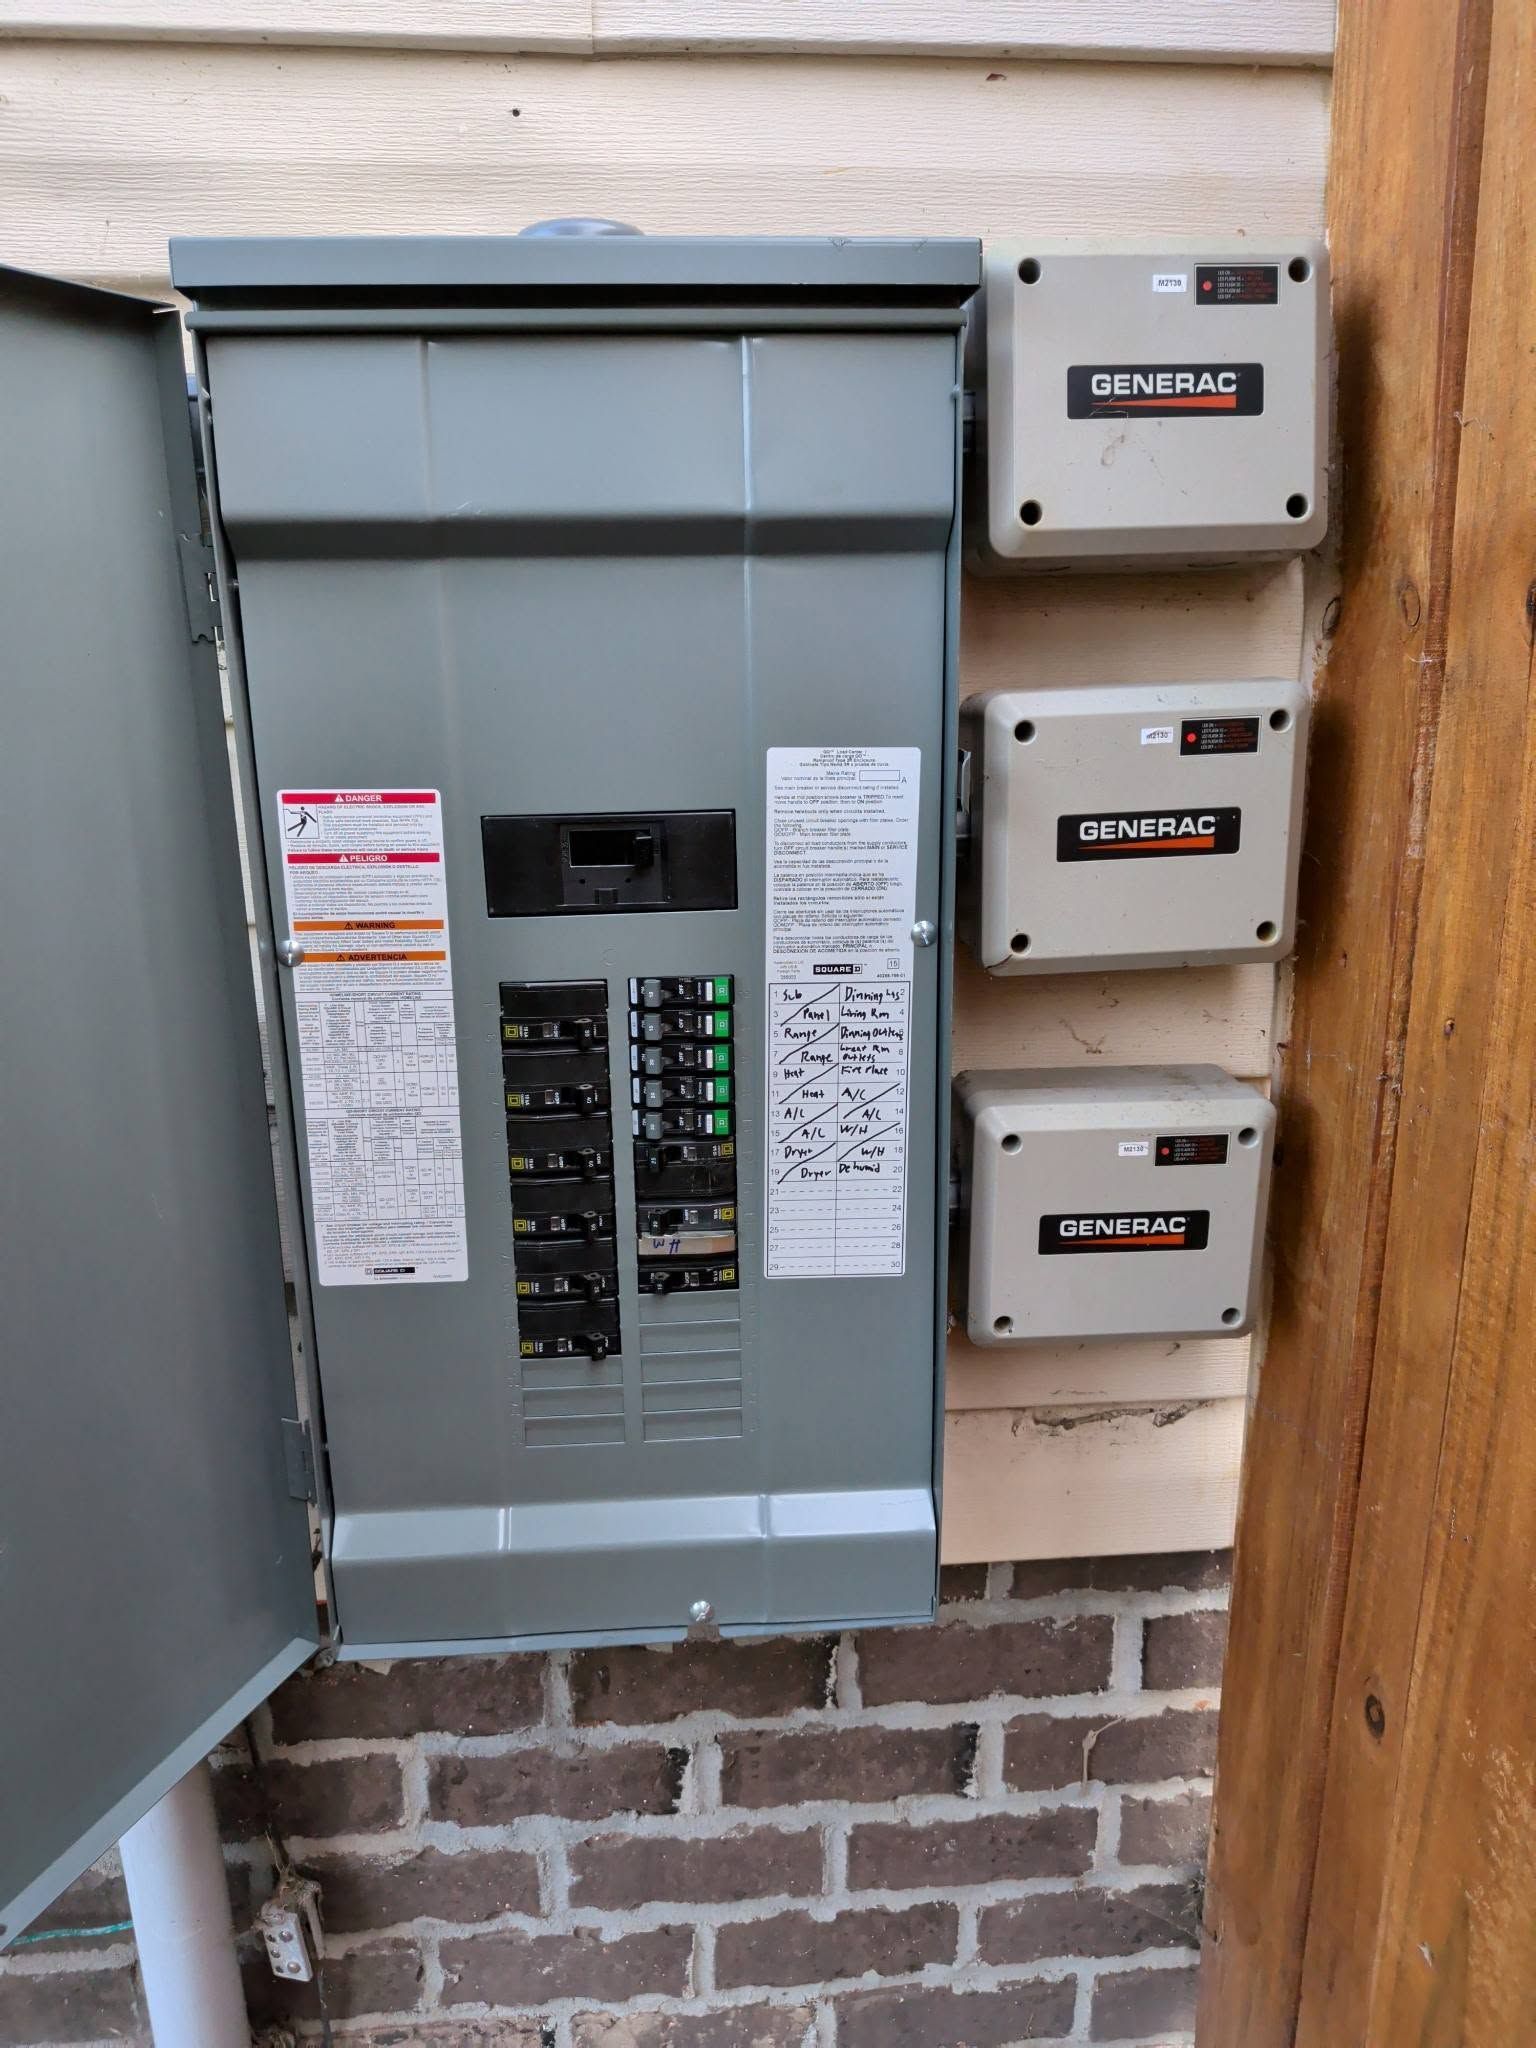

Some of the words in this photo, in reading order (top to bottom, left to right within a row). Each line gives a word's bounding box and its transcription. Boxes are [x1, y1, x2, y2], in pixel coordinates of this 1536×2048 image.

[1092, 373, 1237, 395] GENERAC
[1080, 816, 1215, 840] GENERAC
[815, 965, 852, 973] SQUARE
[783, 989, 802, 1000] Sub
[845, 987, 883, 1004] Dinning
[804, 1008, 830, 1021] Panel
[841, 1006, 866, 1020] Living
[871, 1009, 889, 1019] Rm
[785, 1028, 817, 1041] Range
[841, 1026, 871, 1040] Dinning
[873, 1045, 889, 1053] Rm
[801, 1052, 833, 1065] Range
[784, 1069, 804, 1079] Heat
[841, 1066, 862, 1075] Fire
[802, 1090, 824, 1098] Heat
[841, 1088, 866, 1101] A/C
[784, 1108, 805, 1120] A/C
[862, 1109, 881, 1120] A/C
[802, 1127, 825, 1140] A/C
[840, 1124, 868, 1136] W/H
[784, 1146, 812, 1158] Dryer
[861, 1147, 885, 1158] W/H
[801, 1168, 831, 1181] Dryer
[1059, 1217, 1185, 1236] GENERAC
